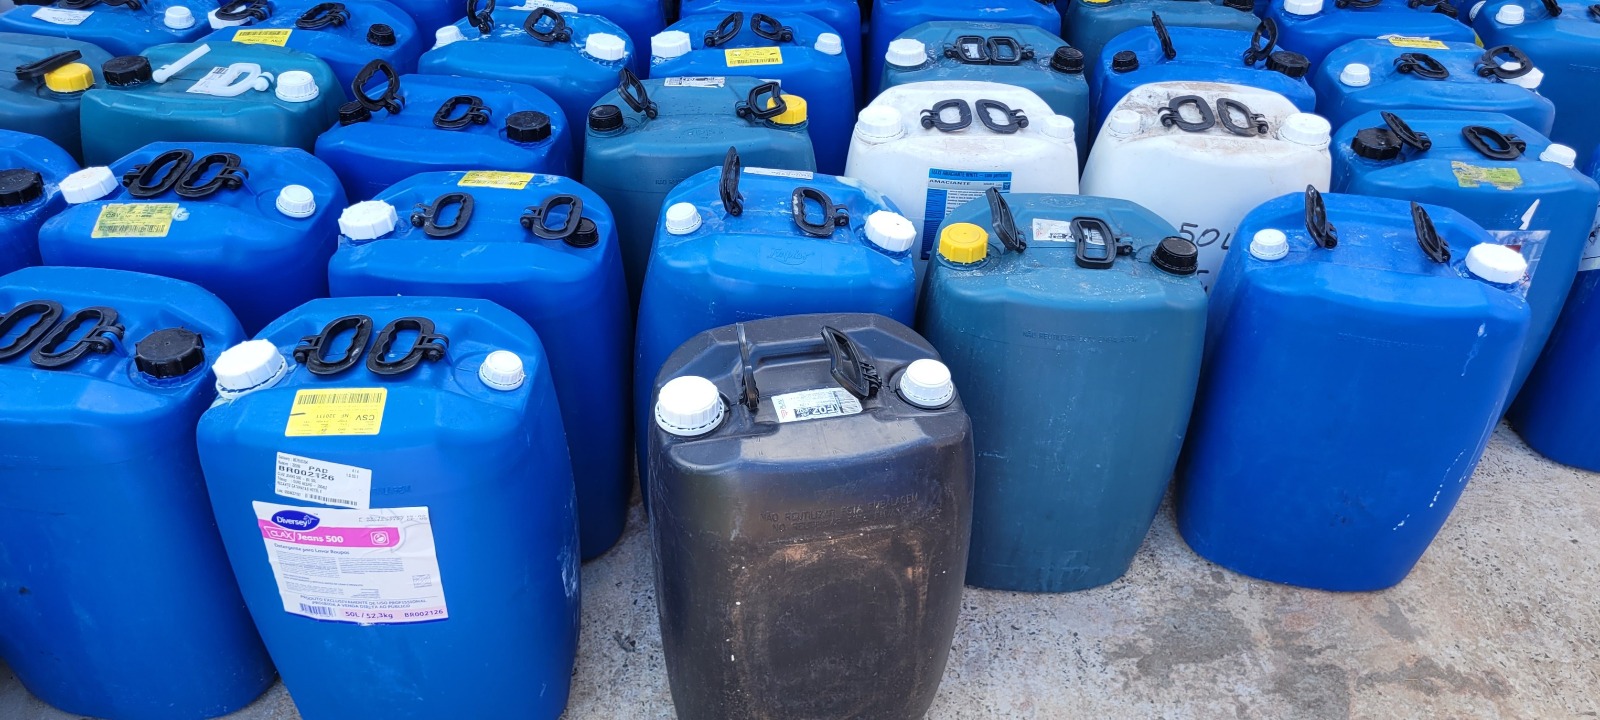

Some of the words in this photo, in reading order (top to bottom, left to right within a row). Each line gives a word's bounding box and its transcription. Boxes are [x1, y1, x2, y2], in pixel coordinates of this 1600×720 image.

[1179, 222, 1231, 250] 50L
[278, 465, 335, 481] BR002126
[308, 465, 329, 474] PAD
[276, 515, 308, 527] Diversey
[270, 530, 293, 539] CLAX
[297, 533, 324, 542] Jeans
[325, 535, 344, 543] 500
[274, 543, 302, 551] Detergente
[300, 594, 323, 602] PRODUTO
[325, 597, 367, 605] EXCLUSIVAMENTE
[404, 609, 444, 618] BR002126
